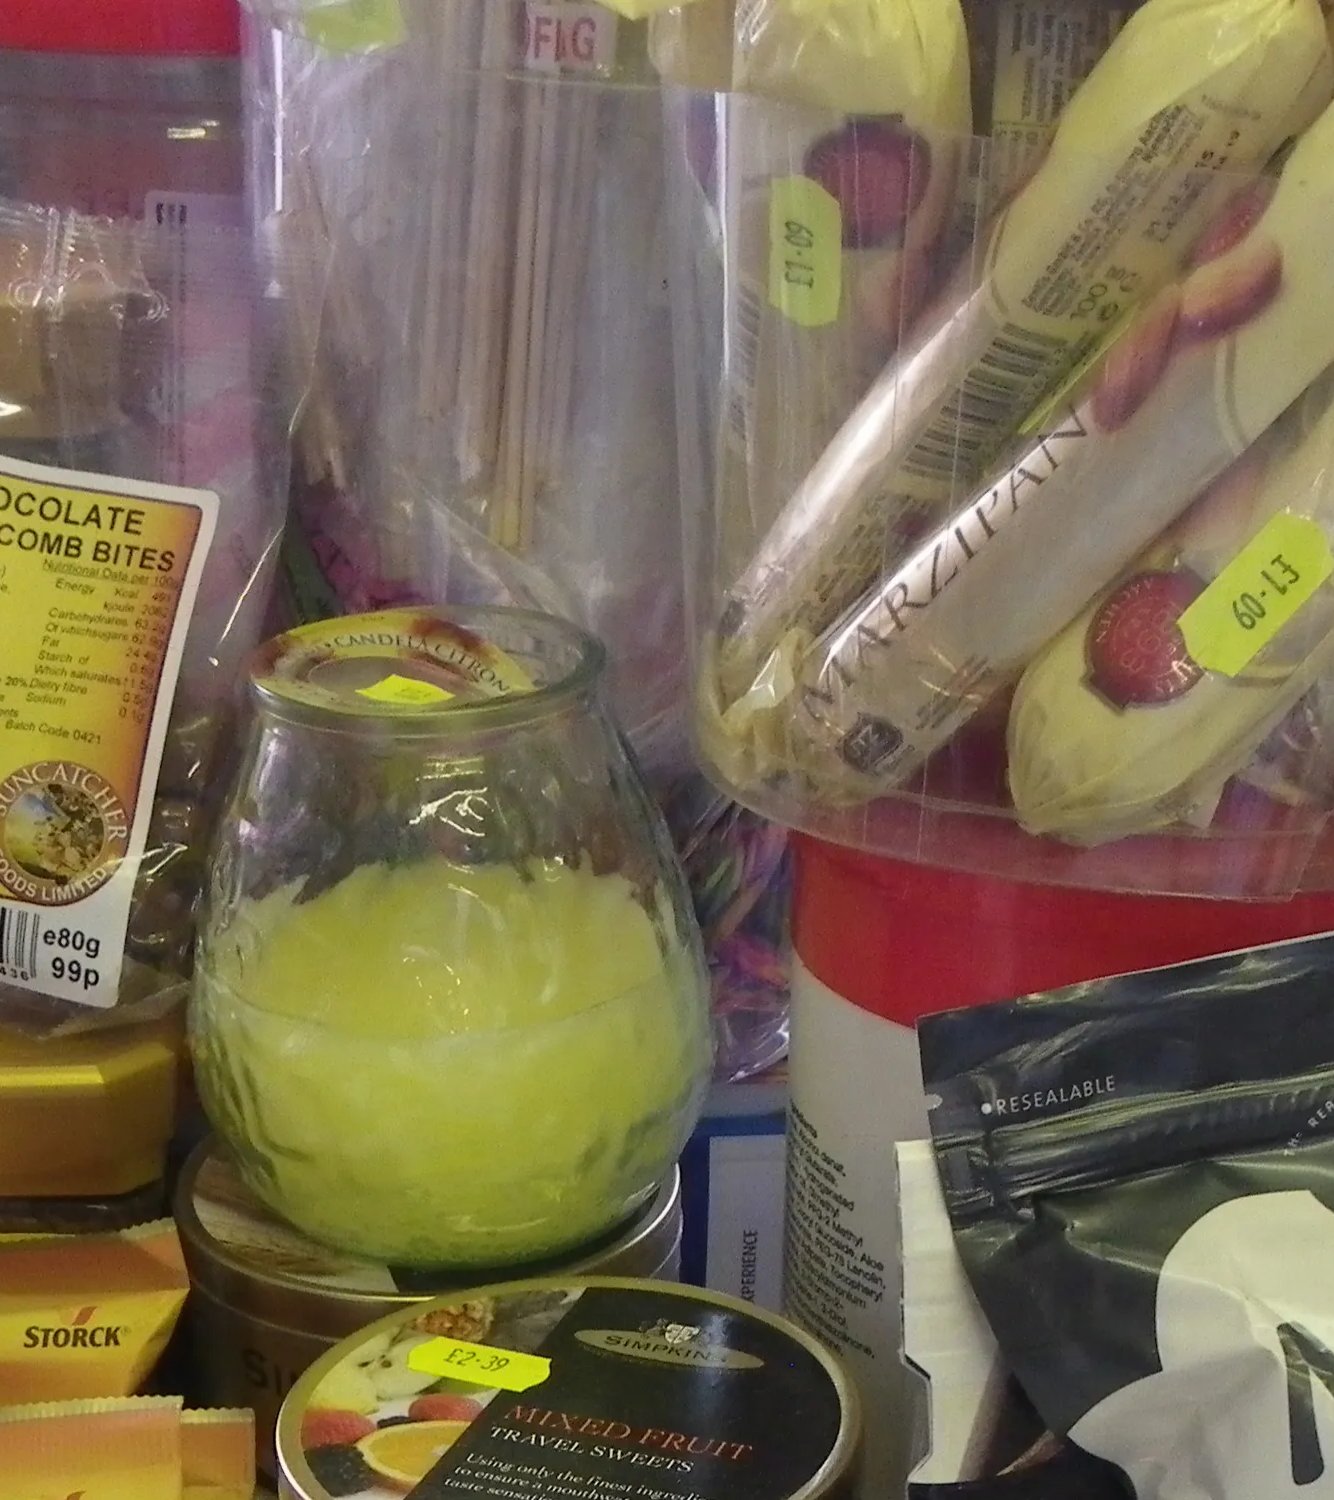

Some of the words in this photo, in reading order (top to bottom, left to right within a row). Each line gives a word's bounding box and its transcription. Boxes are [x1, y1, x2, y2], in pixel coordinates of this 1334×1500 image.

[92, 539, 176, 573] BITES
[800, 405, 1090, 717] MARZIPAN
[332, 630, 428, 658] CANDELA
[41, 866, 107, 901] LIMITED
[50, 955, 101, 990] 99p
[994, 1075, 1117, 1117] RESEALABLE
[22, 1323, 123, 1350] STORCK
[491, 1425, 586, 1455] TRAVEL
[589, 1444, 695, 1475] SWEETS
[504, 1404, 632, 1440] MIXED
[638, 1427, 753, 1461] FRUIT
[454, 1465, 472, 1477] to
[474, 1469, 529, 1488] ensure
[466, 1452, 514, 1475] Using
[516, 1464, 555, 1480] only
[556, 1467, 584, 1484] the
[586, 1472, 634, 1492] finest
